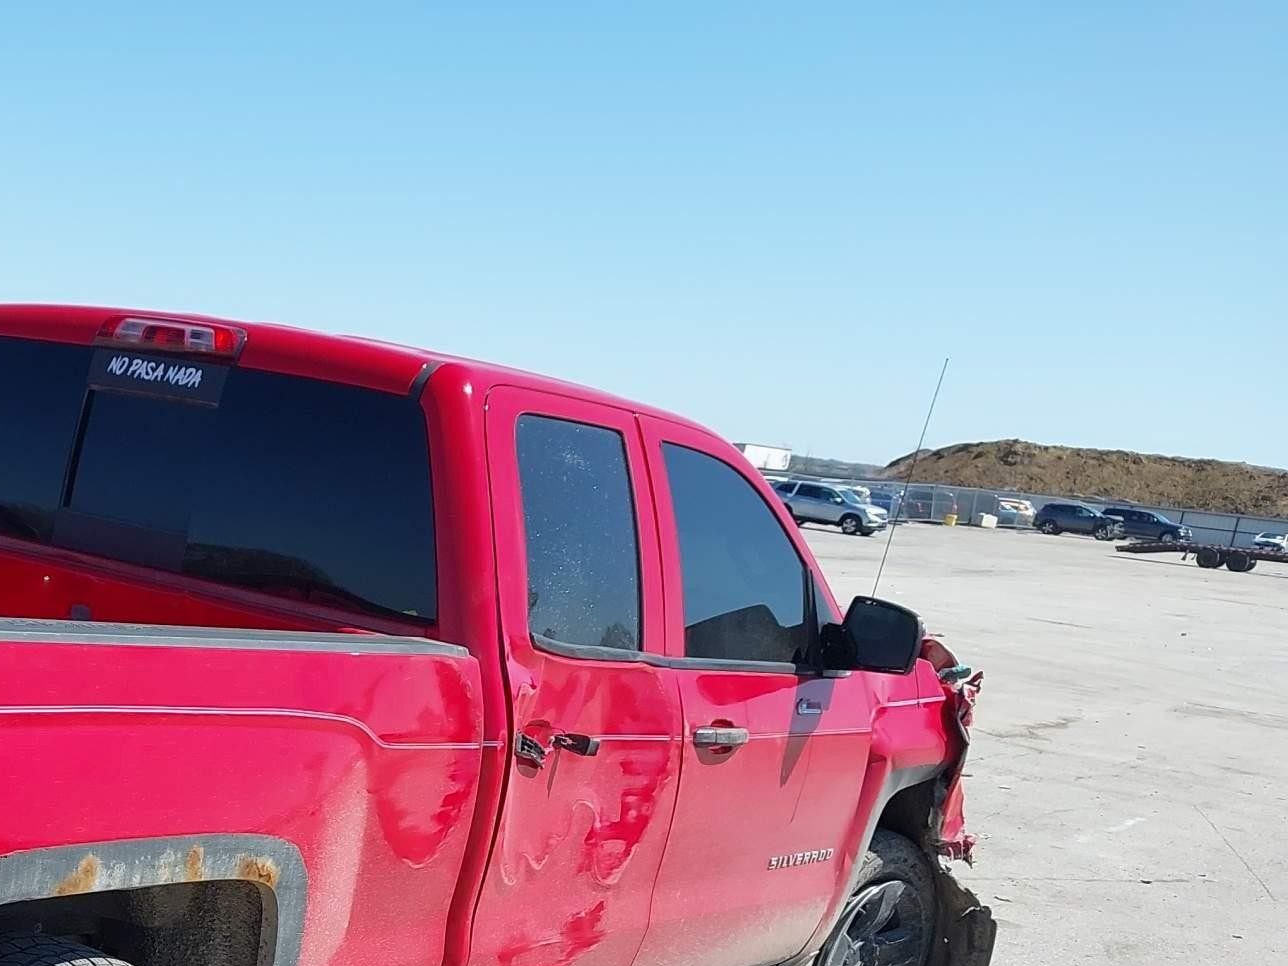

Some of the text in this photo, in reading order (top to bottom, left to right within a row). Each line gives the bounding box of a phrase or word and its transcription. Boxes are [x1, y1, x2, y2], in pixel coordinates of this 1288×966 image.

[107, 355, 203, 389] NO PASA NADA
[767, 847, 834, 871] SILVERADO
